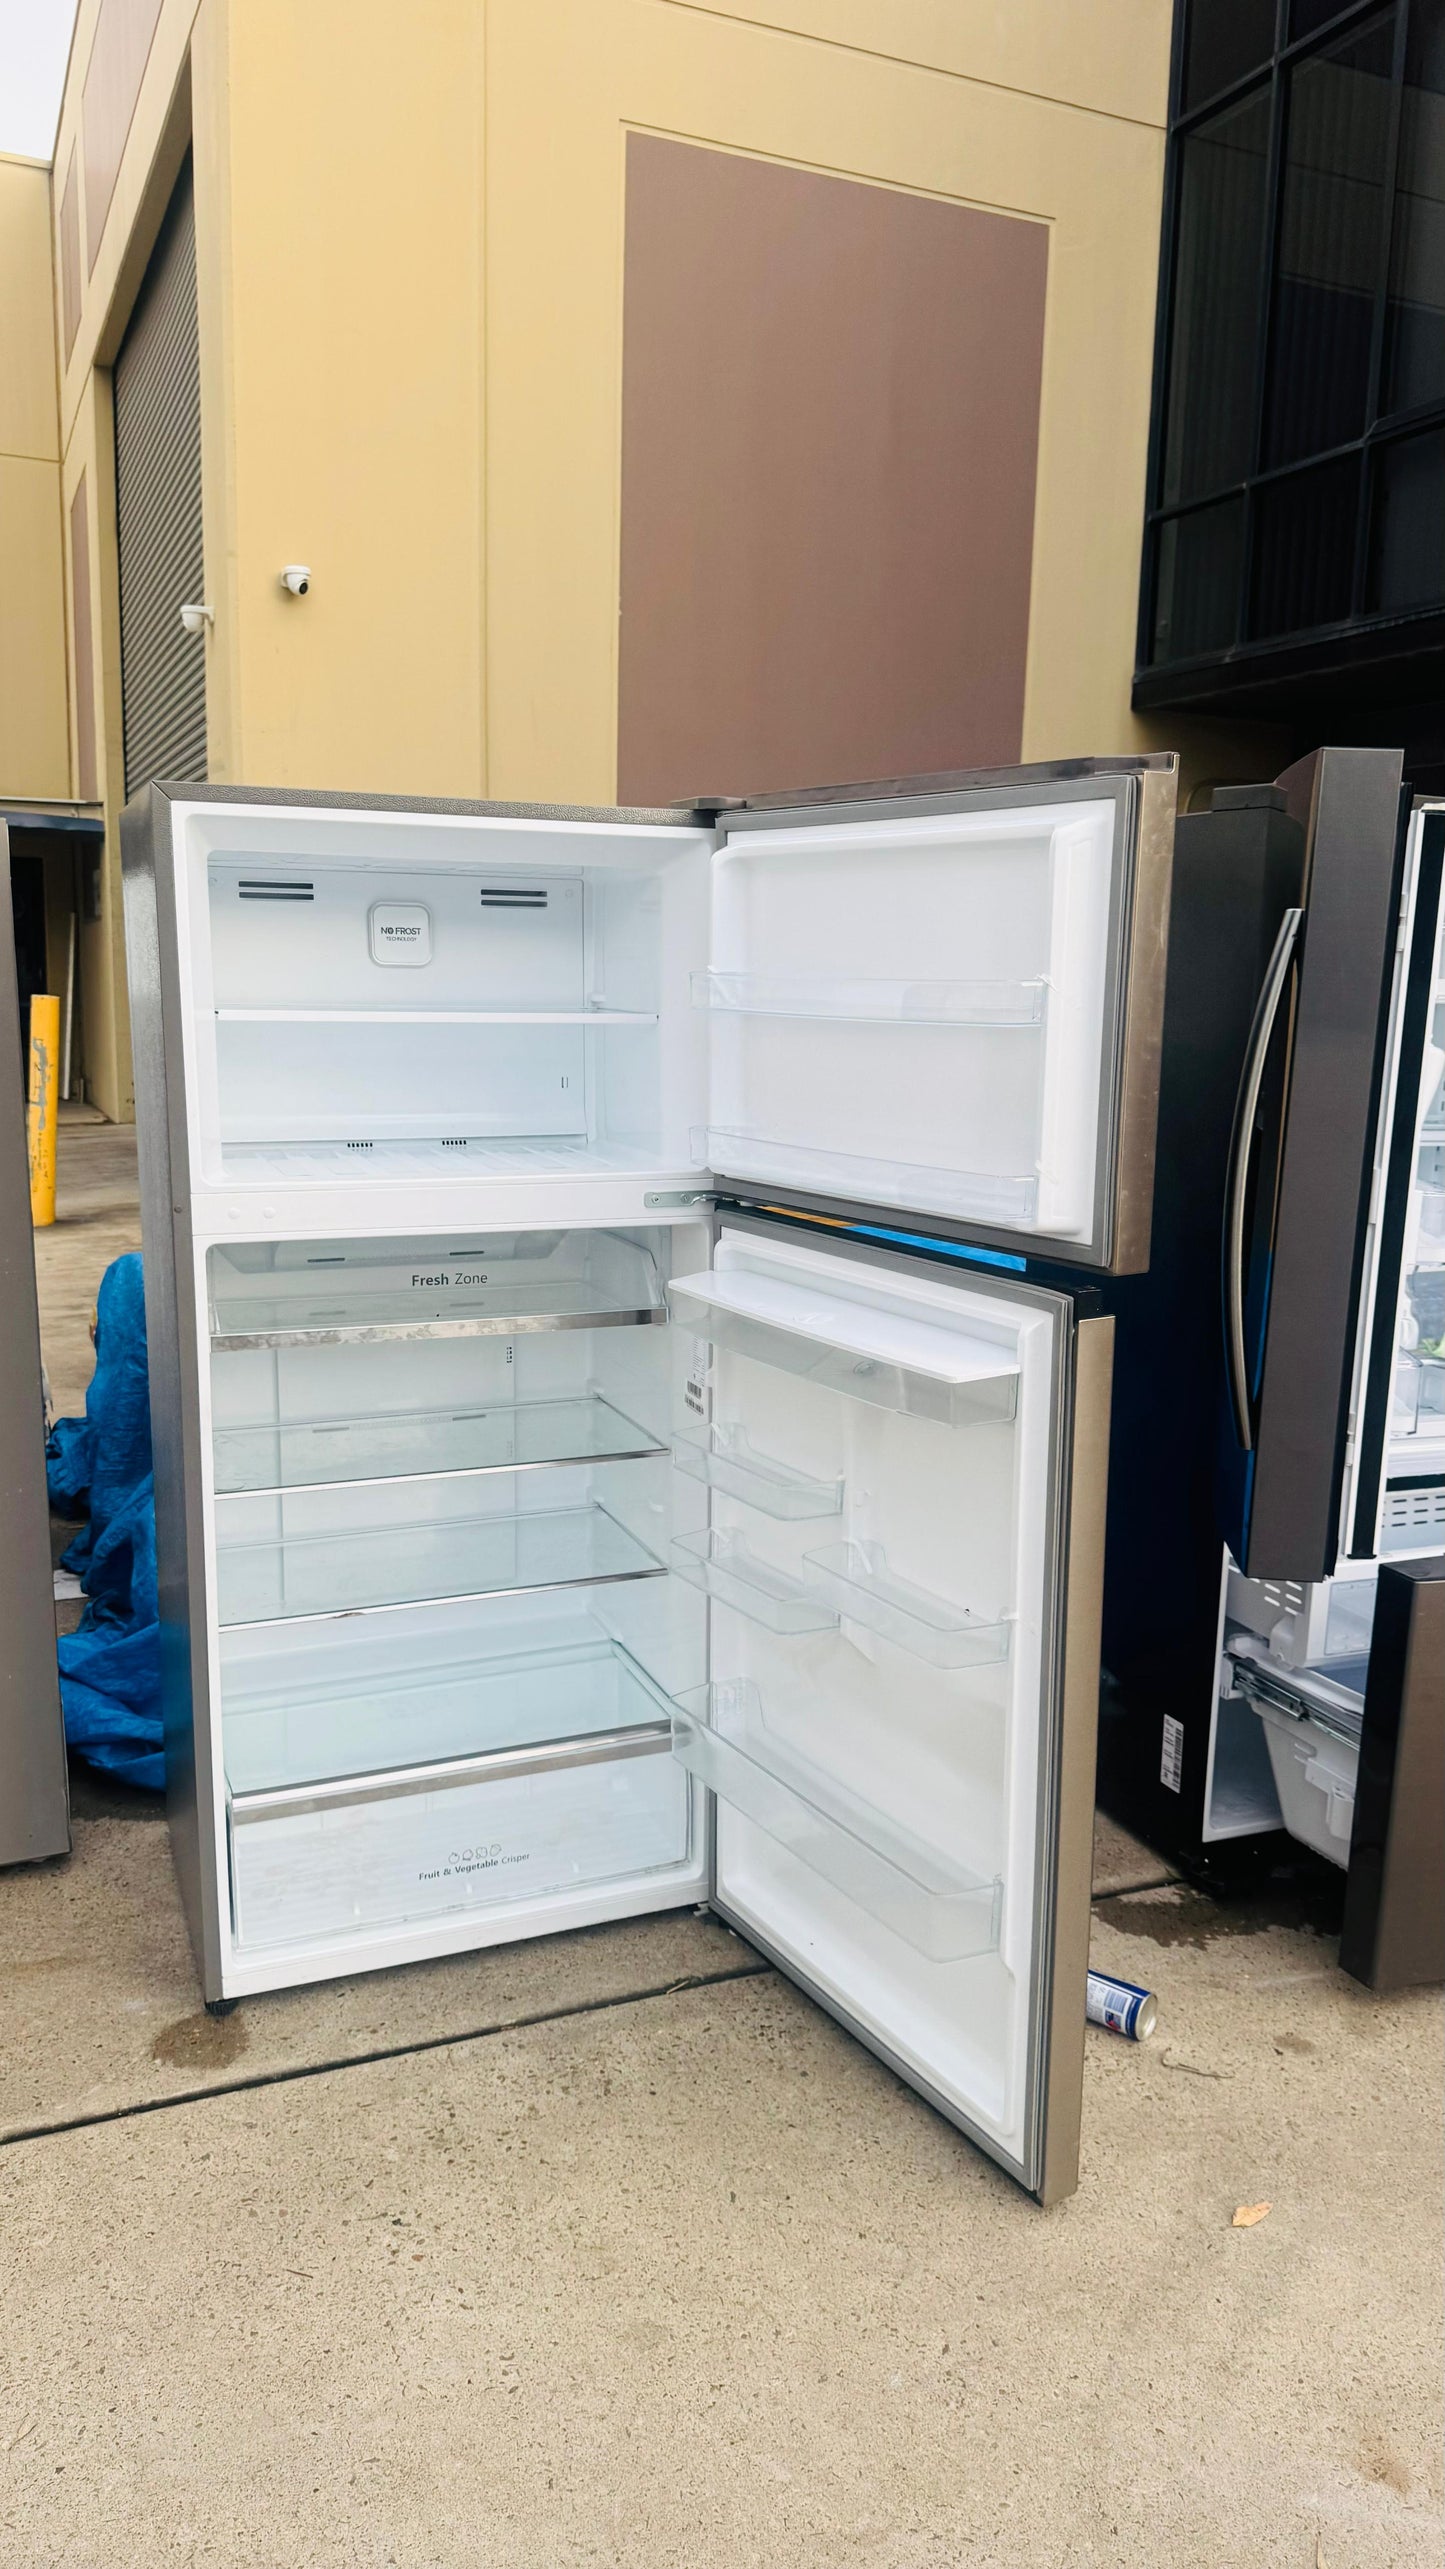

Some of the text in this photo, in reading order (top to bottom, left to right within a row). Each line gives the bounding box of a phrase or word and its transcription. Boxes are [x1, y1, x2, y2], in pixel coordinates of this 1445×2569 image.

[380, 926, 421, 936] NO FROST
[412, 1272, 488, 1287] Fresh Zone
[418, 1853, 530, 1881] Fruit & Vegetable Crisper
